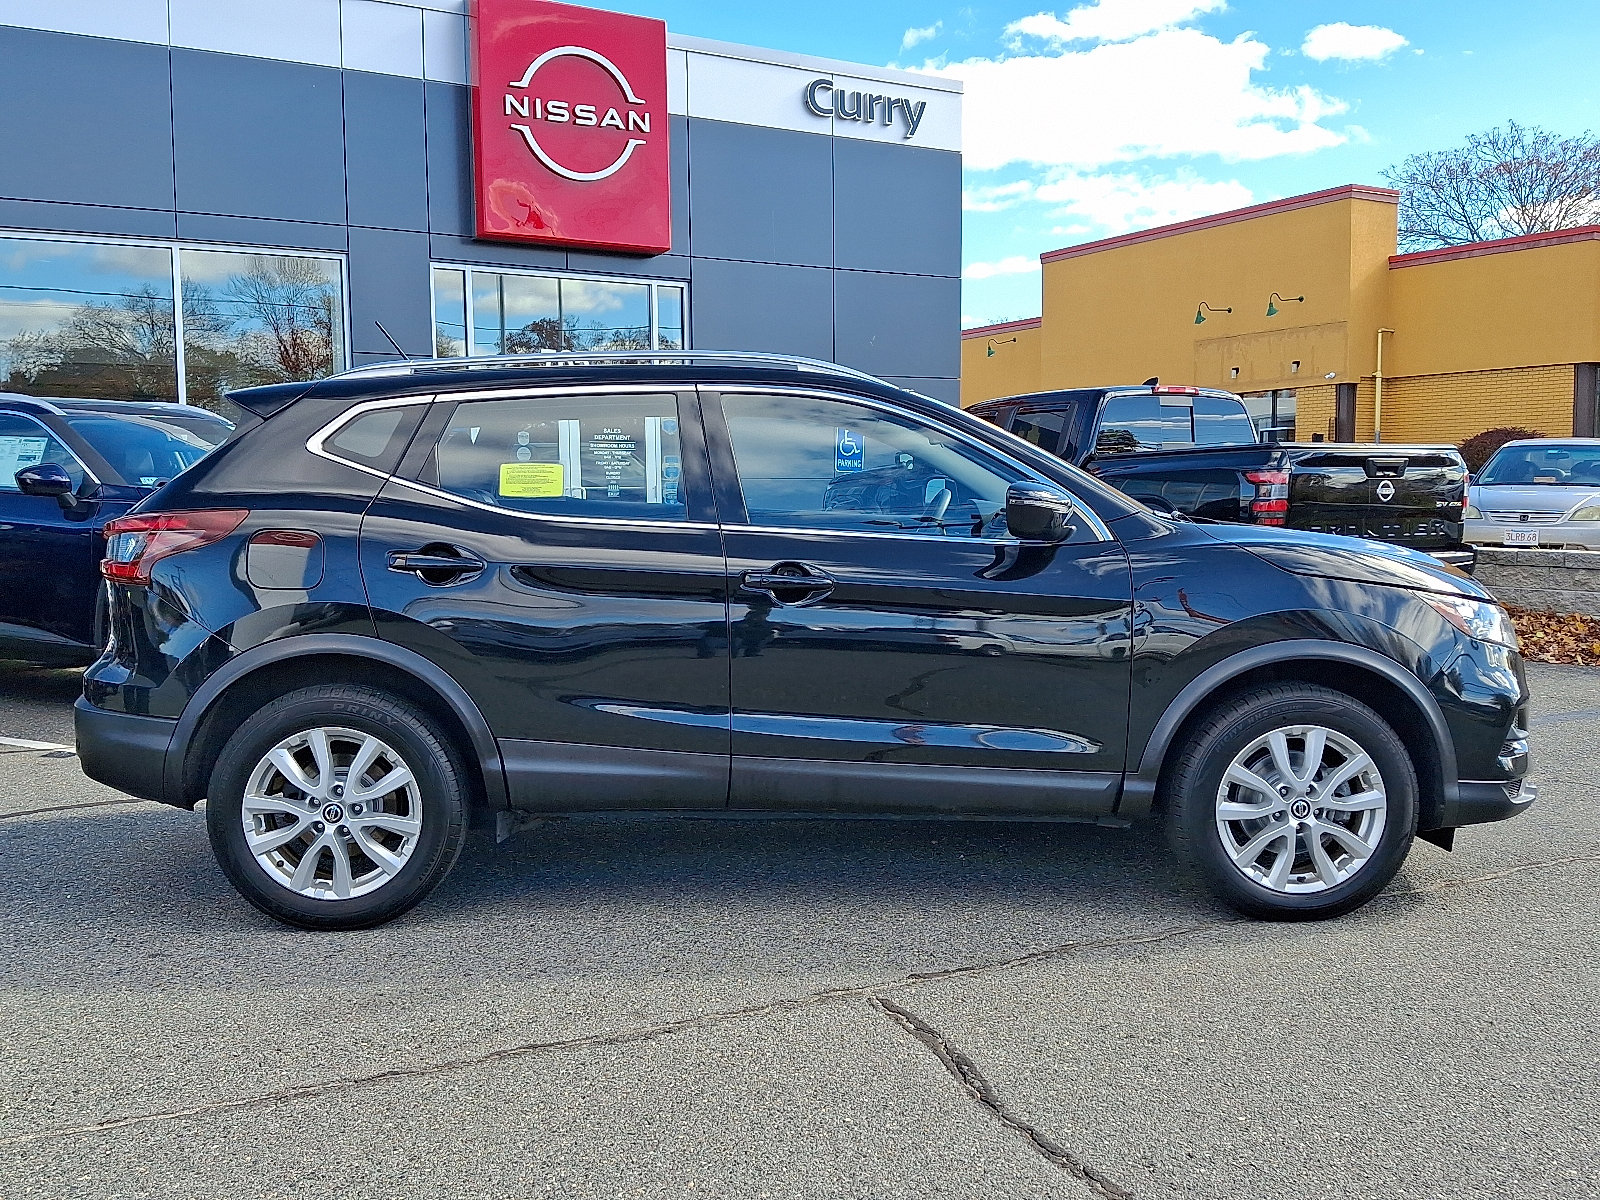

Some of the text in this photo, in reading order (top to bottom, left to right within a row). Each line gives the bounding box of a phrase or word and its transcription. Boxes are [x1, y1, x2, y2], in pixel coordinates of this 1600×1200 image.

[504, 93, 650, 133] NISSAN
[804, 78, 927, 139] Curry
[837, 459, 861, 467] PARKING
